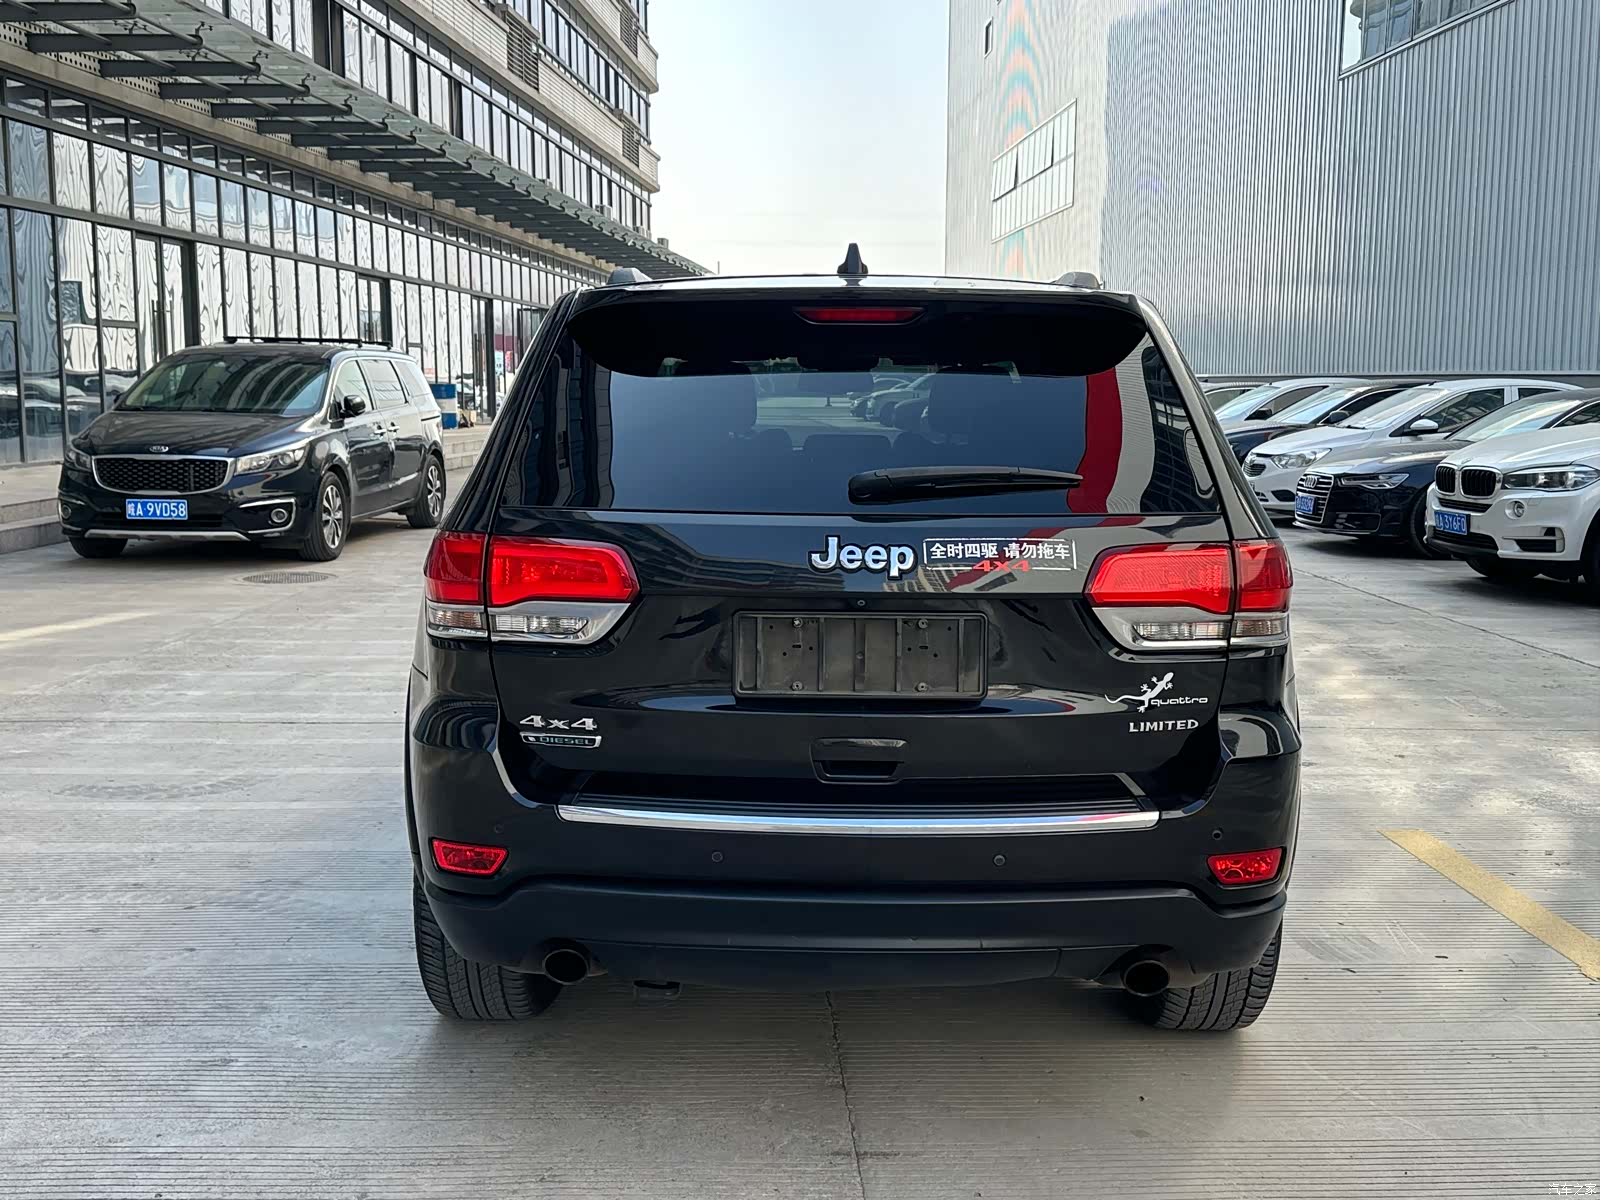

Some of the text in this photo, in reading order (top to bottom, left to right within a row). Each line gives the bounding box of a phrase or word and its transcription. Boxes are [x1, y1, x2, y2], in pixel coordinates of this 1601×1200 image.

[810, 536, 915, 577] Jeep
[930, 542, 1071, 559] 全时四驱 请勿拖车
[1150, 696, 1208, 707] quattro
[1129, 719, 1199, 732] LIMITED
[540, 736, 594, 745] DIESEL
